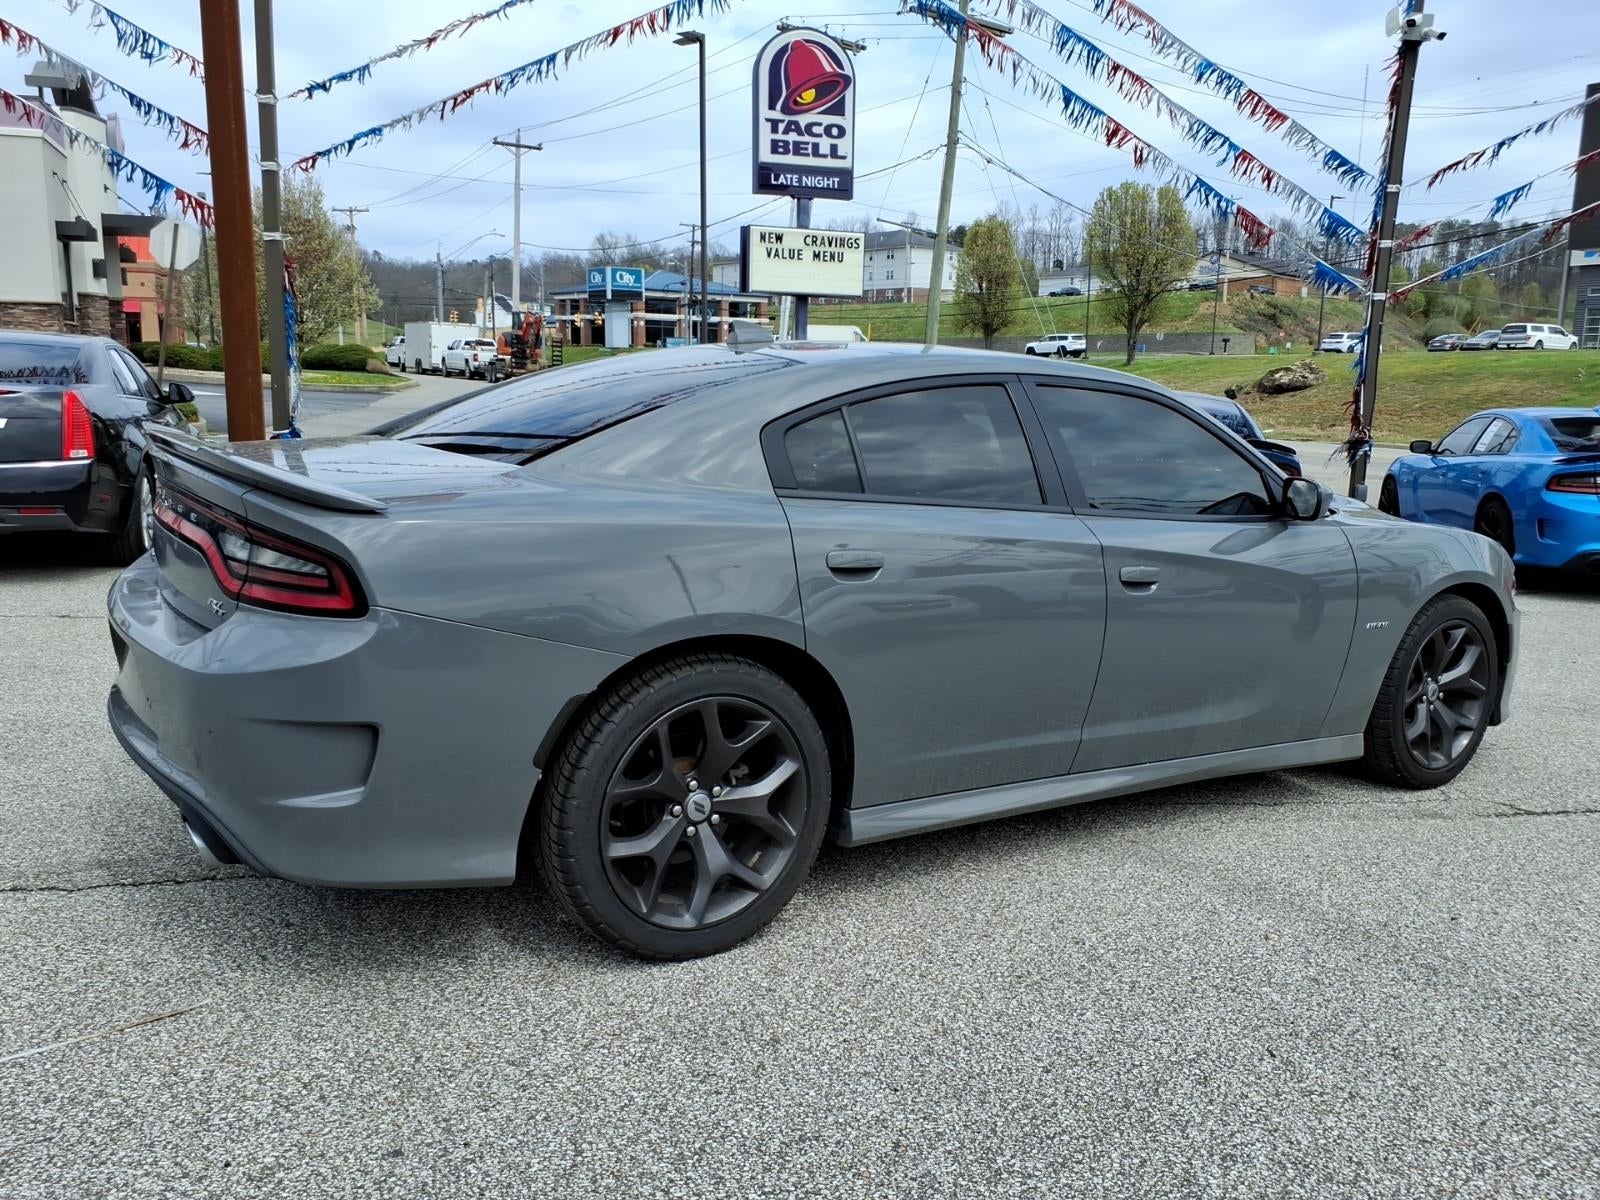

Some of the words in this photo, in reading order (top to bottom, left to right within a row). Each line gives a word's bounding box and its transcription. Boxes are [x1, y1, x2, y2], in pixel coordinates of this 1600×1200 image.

[765, 117, 847, 139] TACO
[770, 138, 847, 160] BELL
[771, 173, 799, 186] LATE
[802, 175, 839, 189] NIGHT
[759, 231, 784, 244] NEW
[803, 235, 861, 249] CRAVINGS
[766, 247, 803, 260] VALUE
[813, 250, 844, 263] MENU
[616, 271, 636, 286] City
